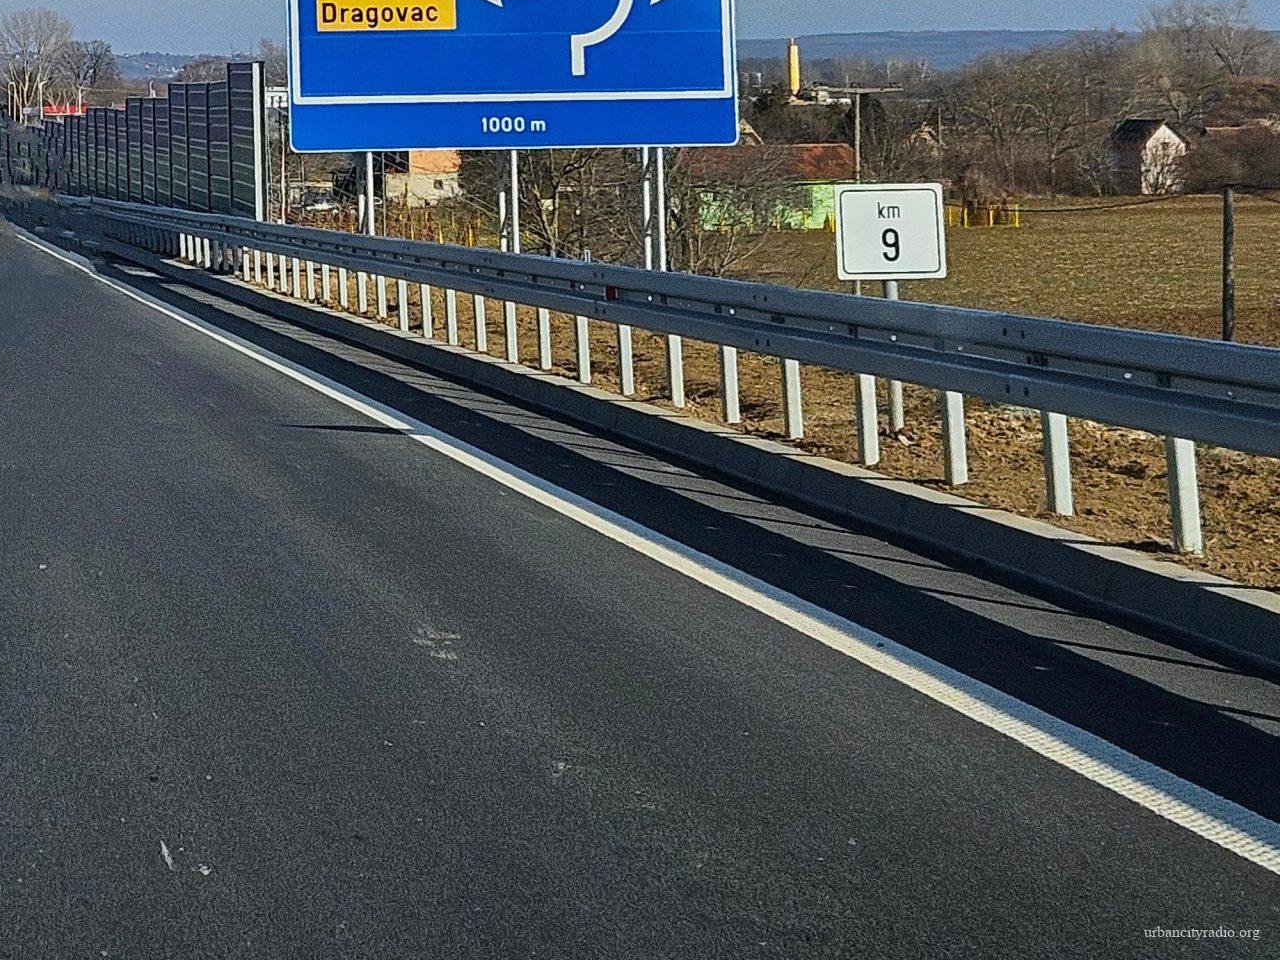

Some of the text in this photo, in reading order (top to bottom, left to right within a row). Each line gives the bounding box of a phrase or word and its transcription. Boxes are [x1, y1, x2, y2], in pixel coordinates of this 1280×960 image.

[322, 2, 439, 28] Dragovac
[481, 117, 546, 132] 1000 m
[877, 202, 900, 219] km
[881, 228, 900, 262] 9
